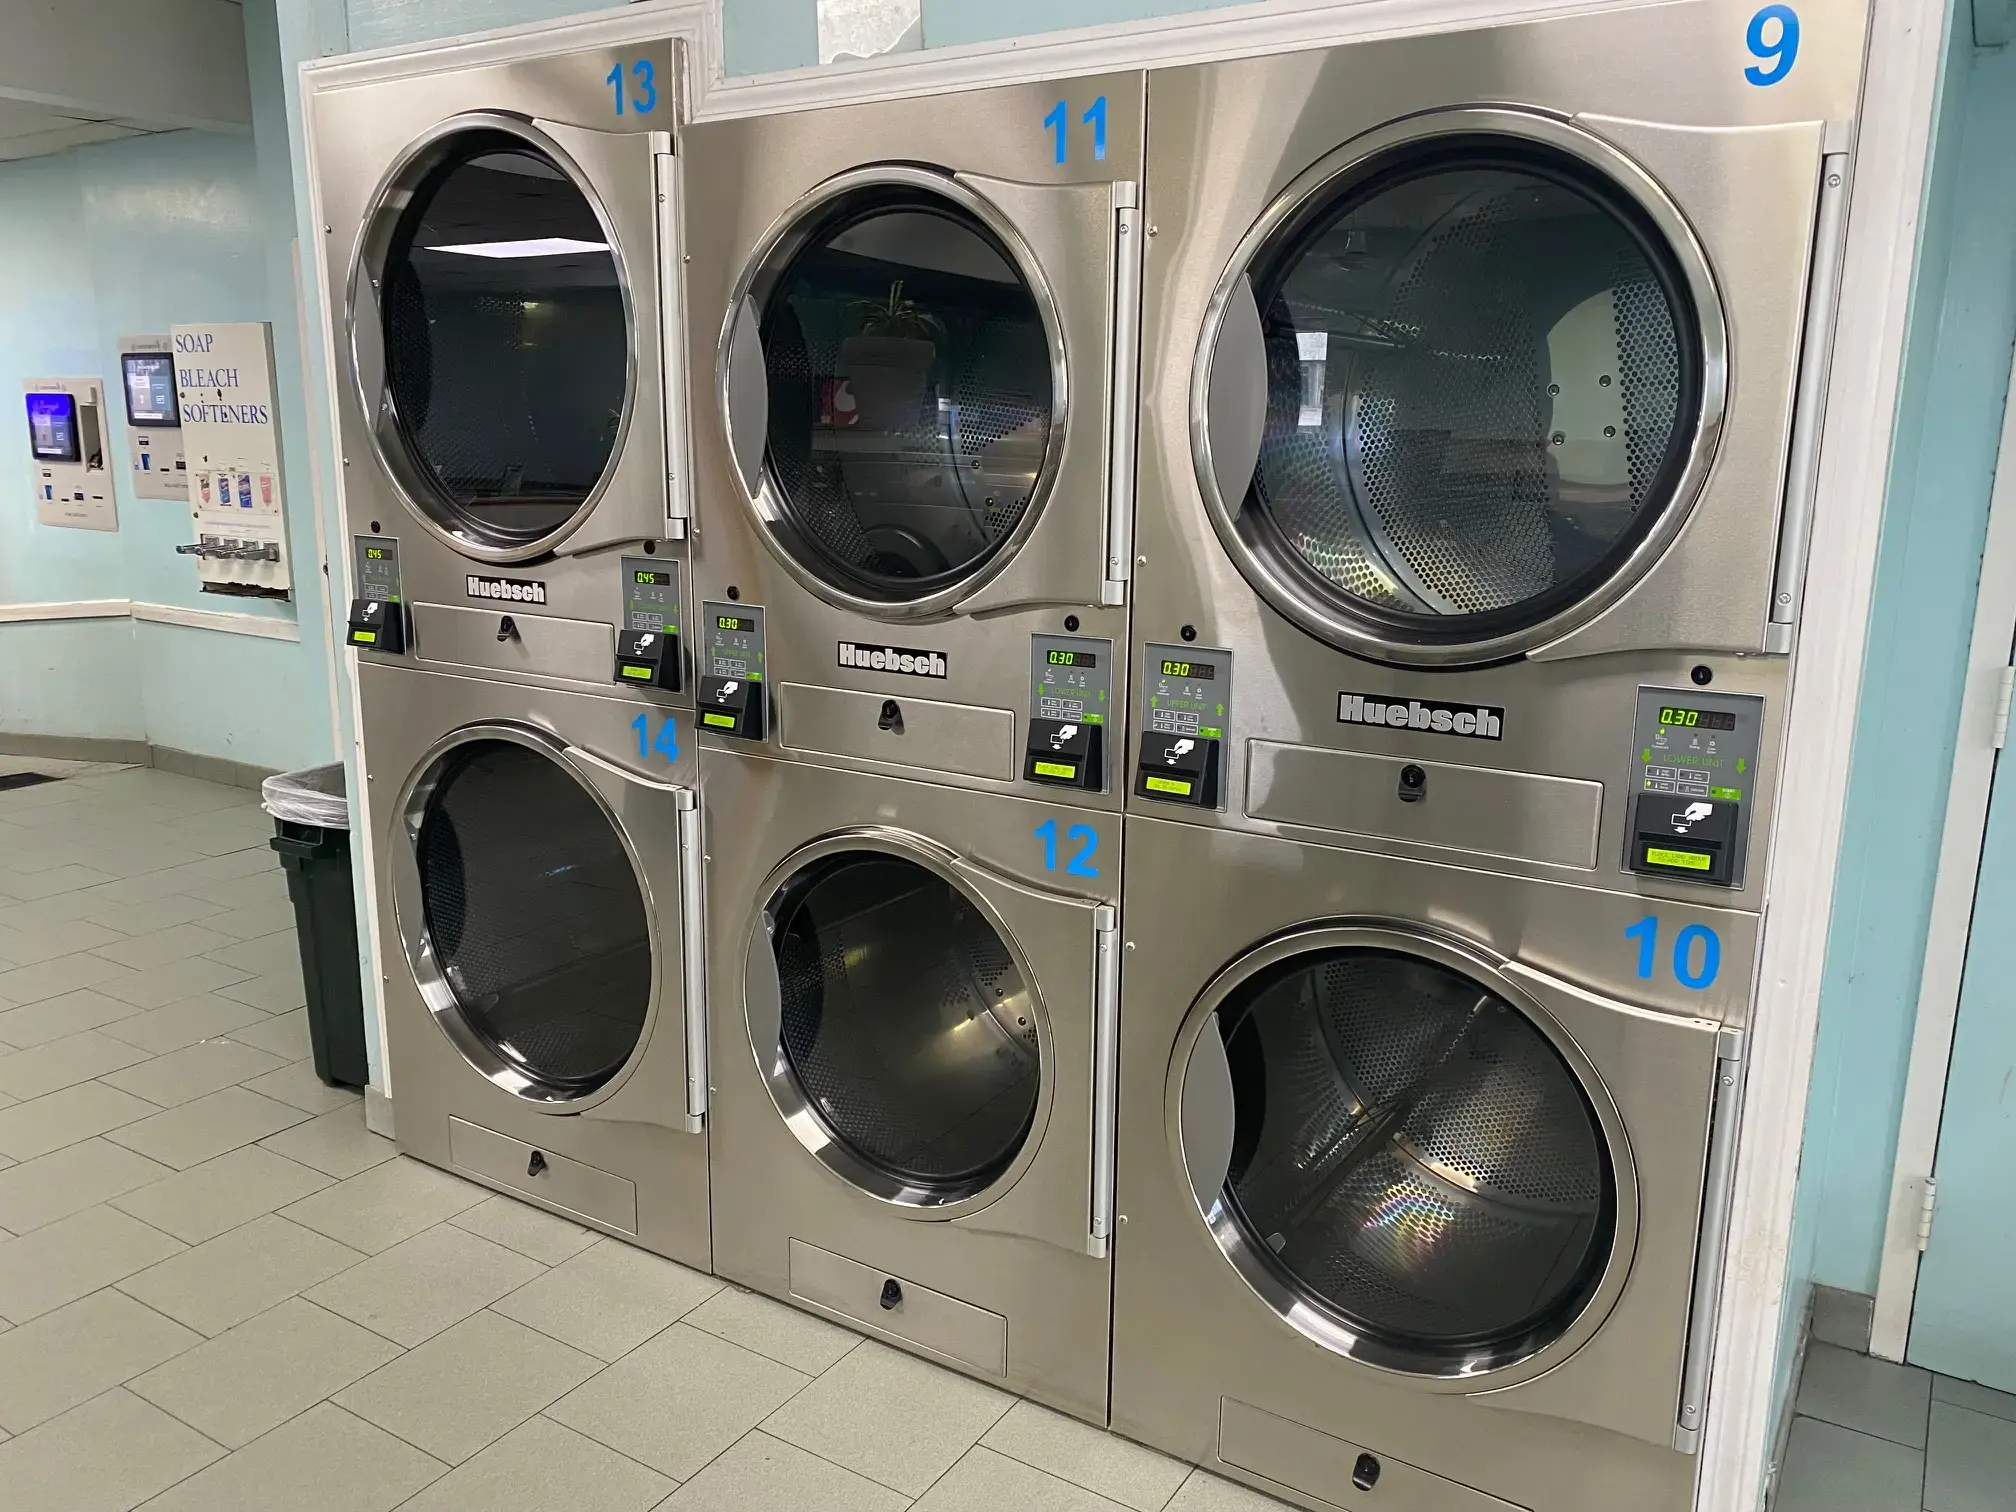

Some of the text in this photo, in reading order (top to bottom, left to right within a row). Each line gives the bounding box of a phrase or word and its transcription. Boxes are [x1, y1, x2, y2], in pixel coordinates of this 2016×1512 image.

[1744, 3, 1800, 87] 9
[606, 60, 657, 115] 13
[1043, 96, 1108, 164] 11
[175, 333, 214, 354] SOAP
[180, 368, 240, 389] BLEACH
[182, 403, 269, 425] SOFTENERS
[467, 575, 546, 603] Huebsch
[718, 616, 739, 630] 0.30
[839, 643, 946, 677] Huebsch
[1049, 651, 1075, 665] 0.30
[1162, 661, 1190, 677] 0.30
[1338, 694, 1501, 738] Huebsch
[1660, 709, 1699, 727] 0.30
[631, 713, 680, 763] 14
[1663, 752, 1724, 768] LOWER UNIT
[1034, 818, 1099, 878] 12
[1624, 915, 1721, 990] 10
